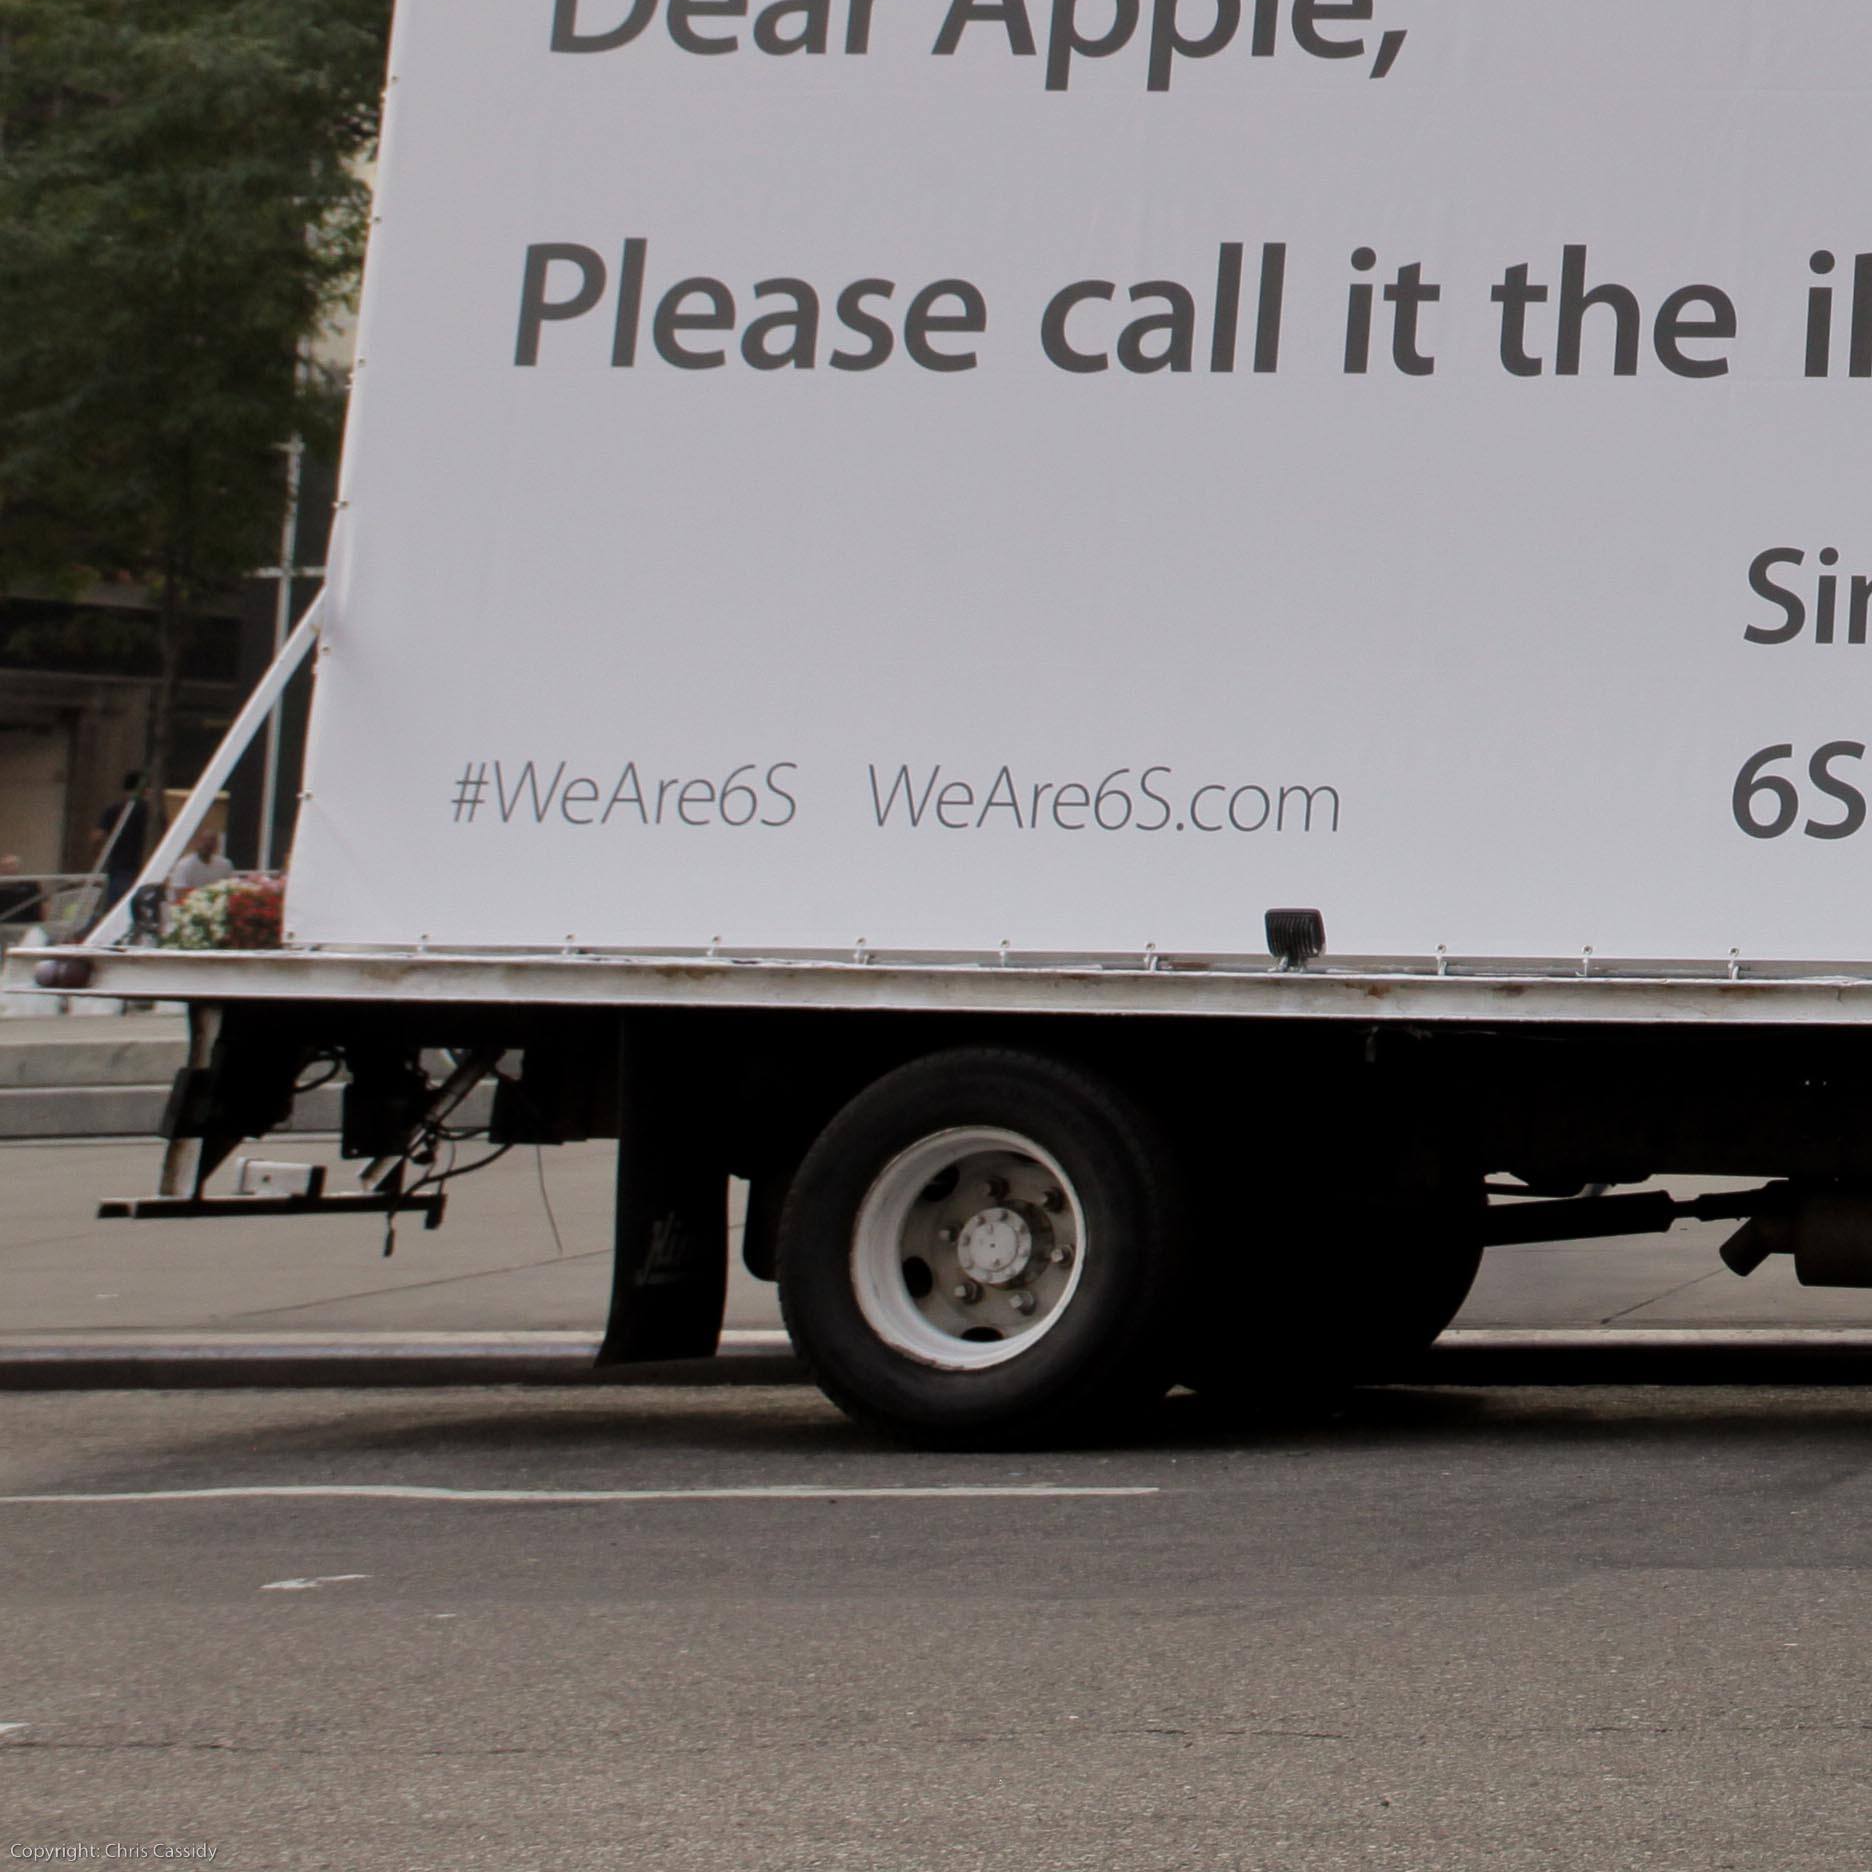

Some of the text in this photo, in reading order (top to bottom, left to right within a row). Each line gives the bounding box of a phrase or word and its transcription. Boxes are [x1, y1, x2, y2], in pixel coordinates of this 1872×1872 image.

[512, 236, 988, 374] Please
[1039, 241, 1288, 375] call
[1342, 245, 1442, 378] it
[1489, 243, 1738, 380] the
[449, 758, 1341, 834] #WeAre6S WeAre6S.com
[1731, 739, 1868, 841] 6S
